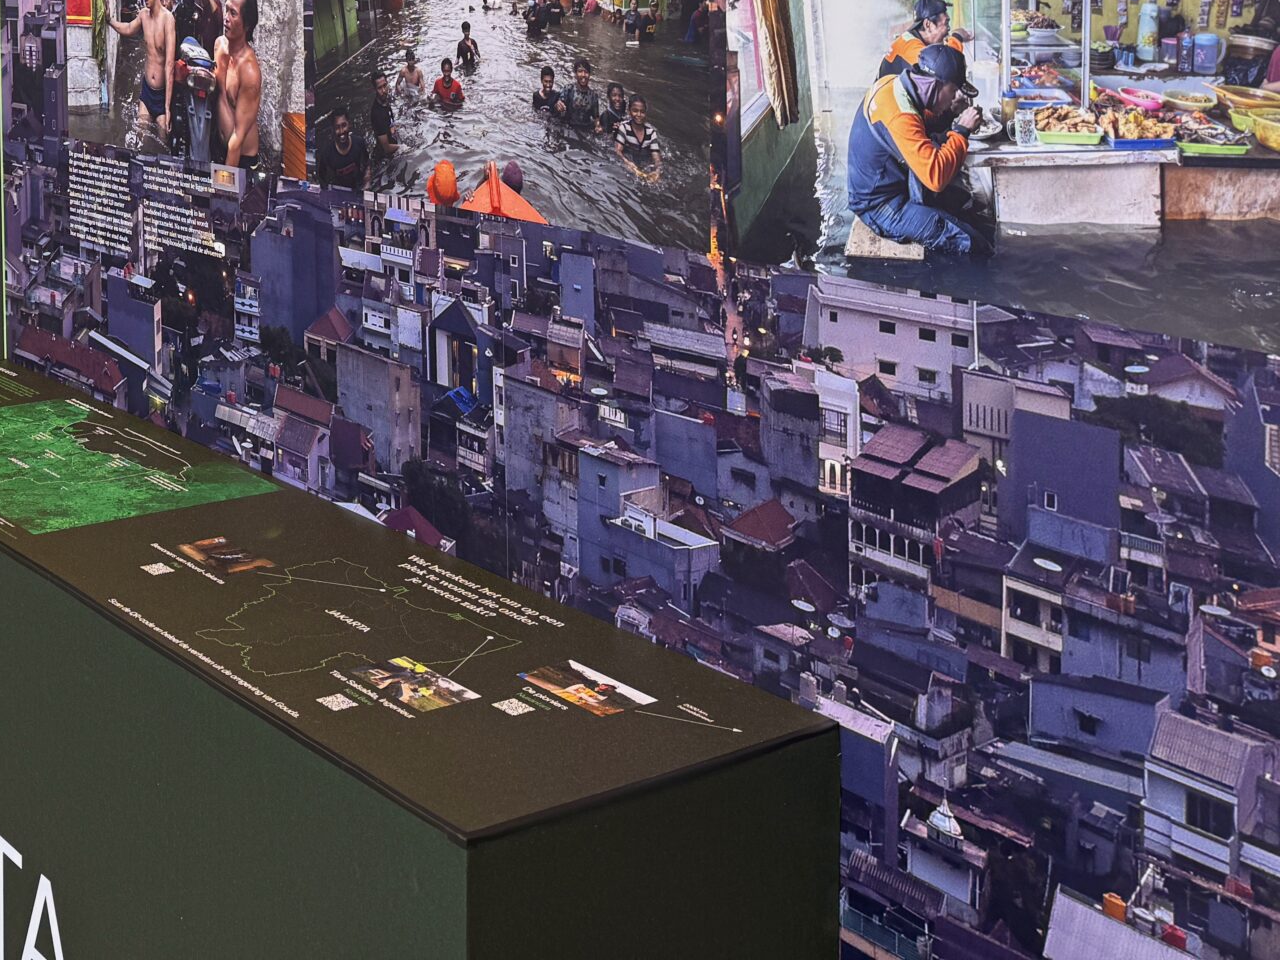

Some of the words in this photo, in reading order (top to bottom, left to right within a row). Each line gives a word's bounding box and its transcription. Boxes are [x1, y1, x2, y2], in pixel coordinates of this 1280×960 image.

[397, 564, 427, 576] plek
[439, 580, 479, 600] wonen
[478, 598, 500, 608] die
[498, 608, 538, 626] onder
[408, 554, 432, 566] Wat
[428, 565, 481, 589] betekent
[478, 588, 502, 598] het
[500, 598, 522, 608] om
[520, 607, 540, 616] op
[539, 616, 565, 628] een
[422, 583, 462, 602] voeten
[460, 602, 496, 617] zakt?
[324, 609, 370, 632] JAKARTA
[522, 686, 536, 694] De
[533, 692, 568, 710] pioniers
